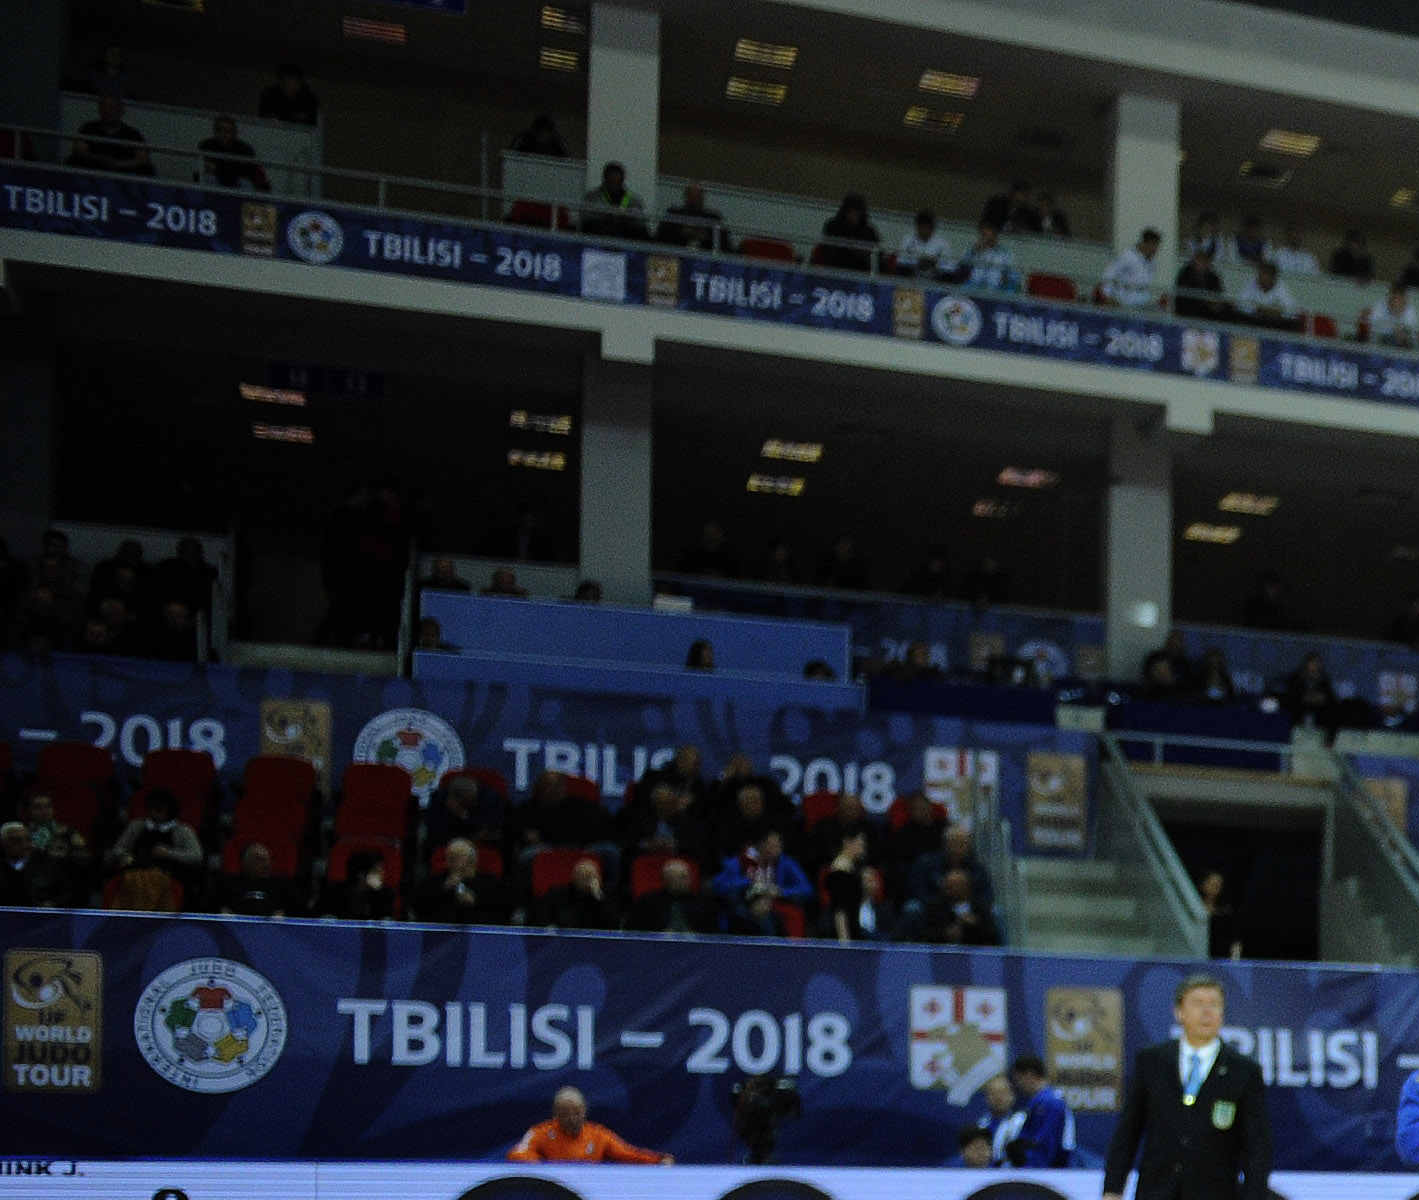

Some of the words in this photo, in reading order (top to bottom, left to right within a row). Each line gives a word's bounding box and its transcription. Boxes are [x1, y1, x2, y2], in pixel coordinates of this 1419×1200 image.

[3, 184, 109, 222] TBILISI
[147, 203, 217, 236] 2018
[364, 231, 461, 268] TBILISI
[495, 248, 562, 282] 2018
[690, 271, 781, 309] TBILISI
[811, 288, 874, 322] 2018
[993, 312, 1079, 349] TBILISI
[1105, 329, 1163, 361] 2018
[1279, 355, 1358, 387] TBILISI
[770, 755, 896, 814] 2018
[15, 1025, 92, 1044] WORLD
[19, 1045, 92, 1063] JUDO
[337, 998, 594, 1071] TBILISI
[686, 1007, 853, 1078] 2018
[13, 1063, 92, 1087] TOUR
